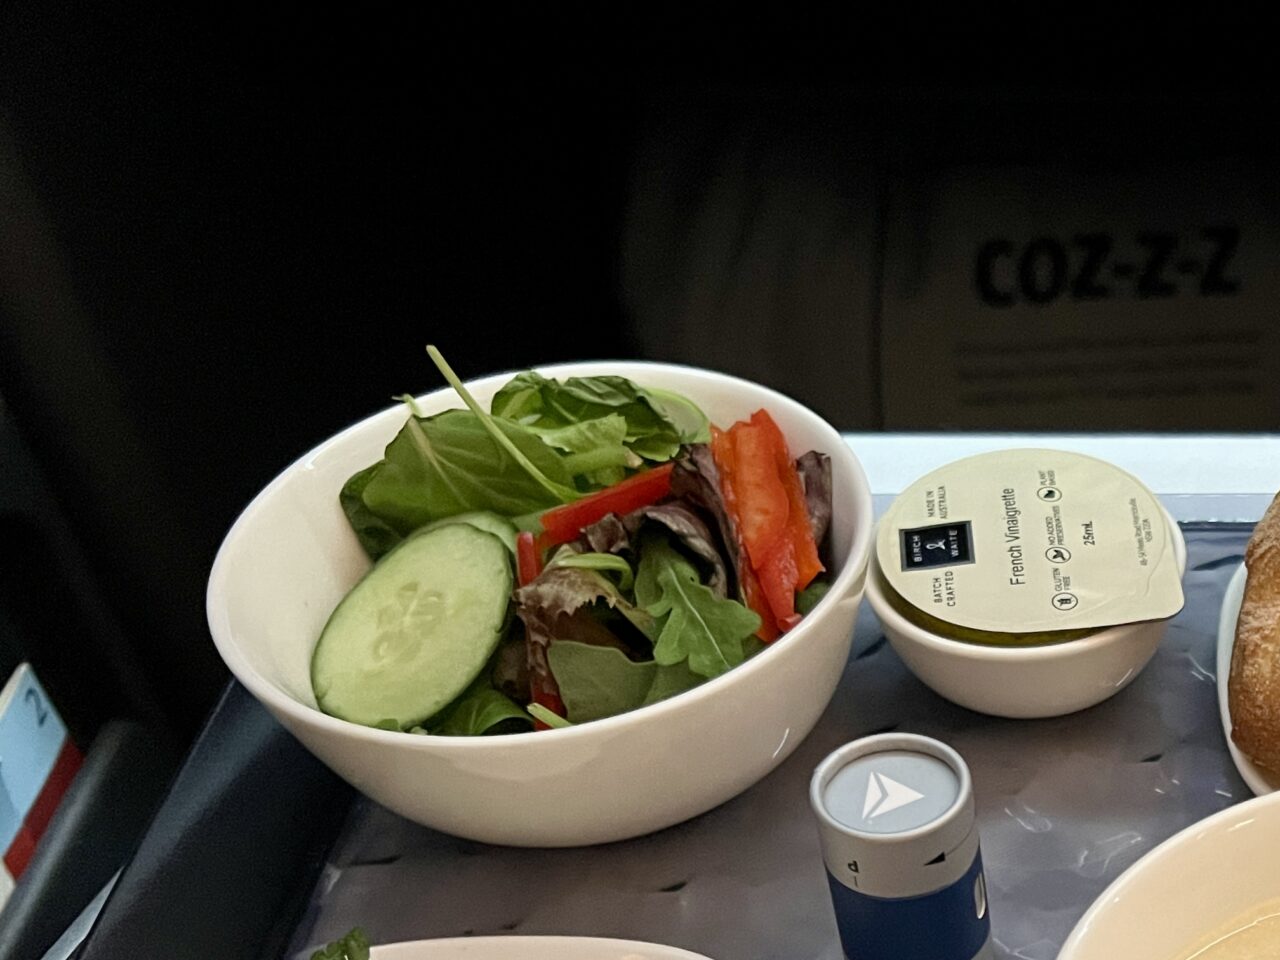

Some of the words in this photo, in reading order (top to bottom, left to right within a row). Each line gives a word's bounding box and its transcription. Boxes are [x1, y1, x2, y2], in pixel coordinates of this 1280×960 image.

[975, 222, 1243, 308] COZ-Z-Z
[926, 499, 935, 518] MADE
[937, 485, 948, 519] AUSTRALIA
[1001, 488, 1022, 543] Vinaigrette
[948, 528, 959, 557] WAITE
[1081, 520, 1096, 546] 25mL
[912, 535, 923, 562] BIRCH
[1008, 545, 1026, 586] French
[1052, 567, 1063, 592] GLUTEN
[932, 577, 943, 604] BATCH
[944, 571, 956, 607] CRAFTED
